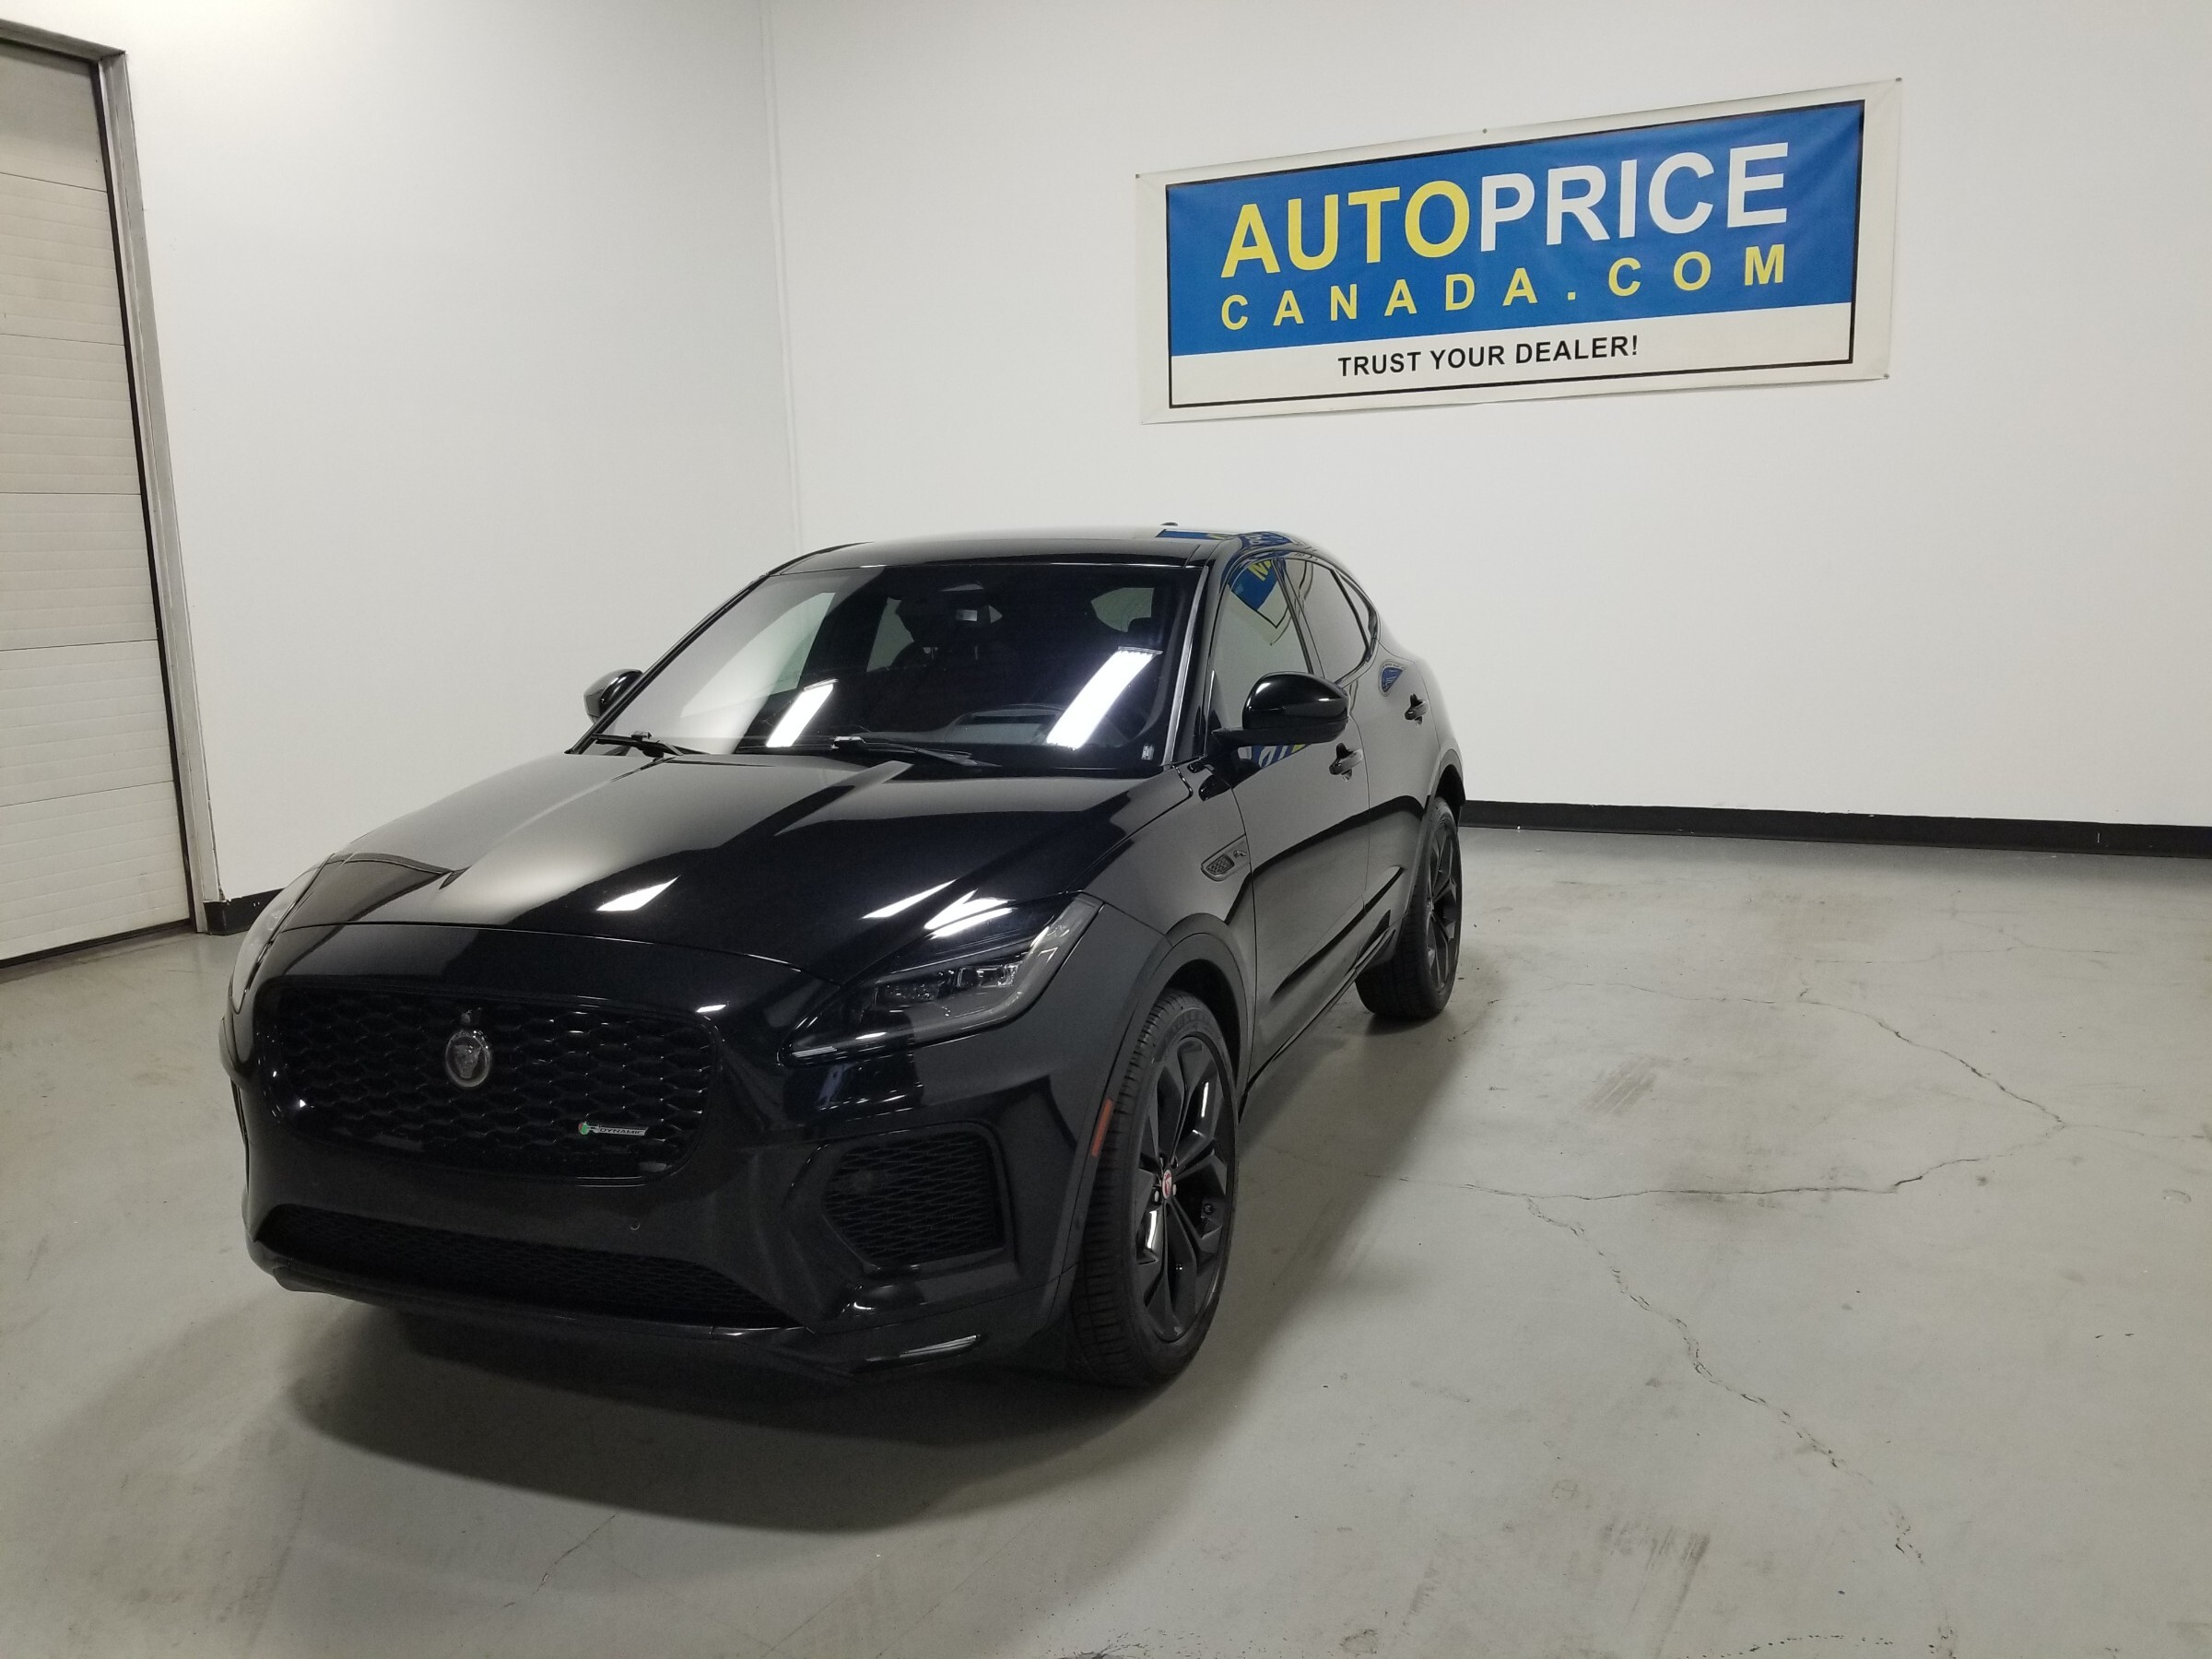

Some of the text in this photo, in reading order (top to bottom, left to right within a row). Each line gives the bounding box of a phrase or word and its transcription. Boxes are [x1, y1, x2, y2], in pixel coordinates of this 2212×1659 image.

[1220, 142, 1790, 278] AUTOPRICE
[1221, 243, 1786, 332] CANADA.COM
[1337, 335, 1638, 378] TRUST YOUR DEALER!
